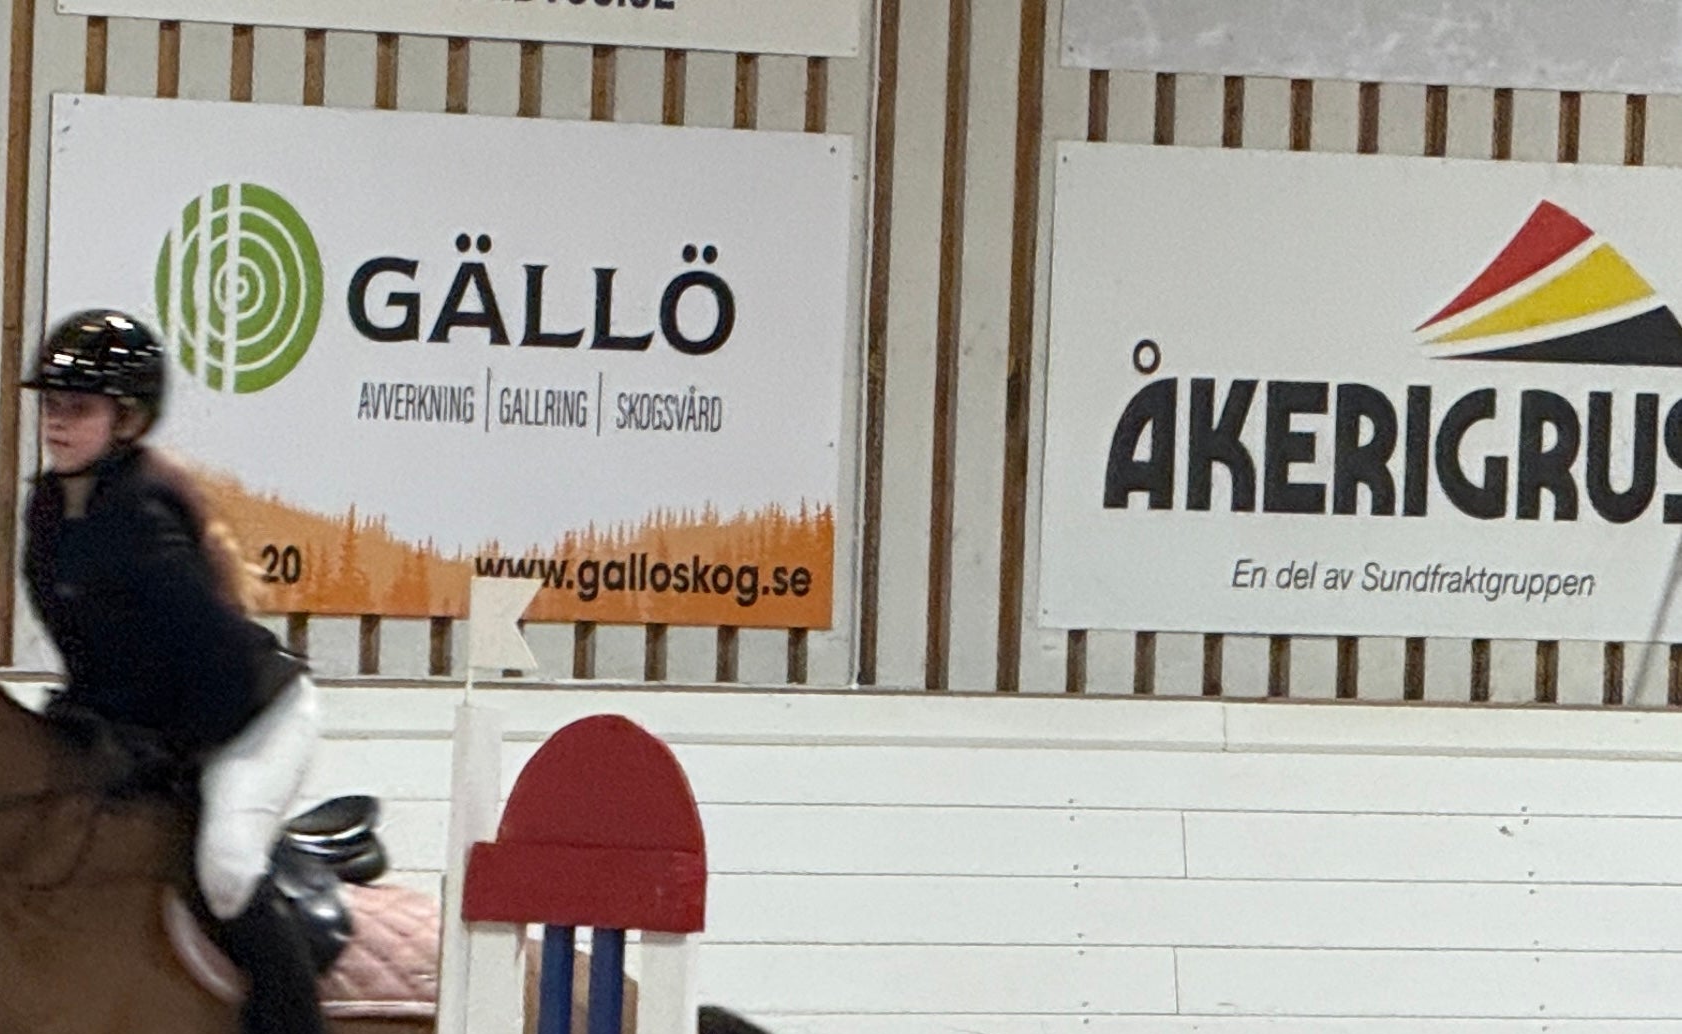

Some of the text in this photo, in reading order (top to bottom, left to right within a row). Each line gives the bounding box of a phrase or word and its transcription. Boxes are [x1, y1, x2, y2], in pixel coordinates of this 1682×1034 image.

[347, 232, 736, 356] GÄLLÖ
[357, 381, 723, 433] AVVERKNING GALLRING SKOGSVÅRD
[260, 543, 303, 585] 20
[475, 552, 813, 607] www.galloskog.se
[1231, 558, 1596, 603] En del av Sundfraktgruppen
